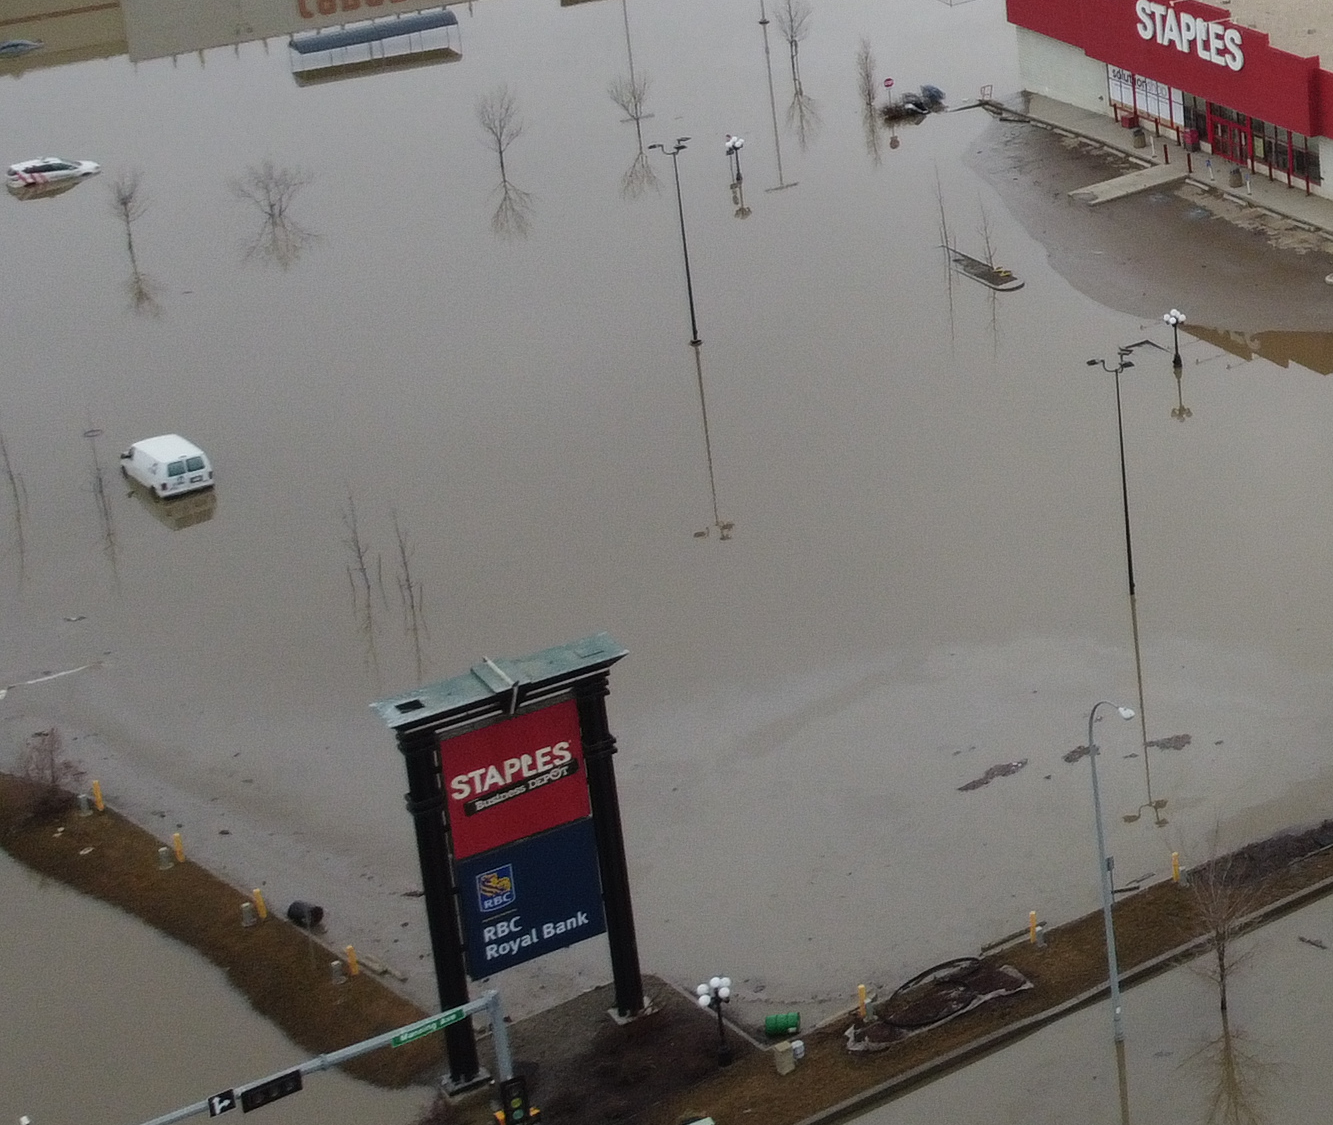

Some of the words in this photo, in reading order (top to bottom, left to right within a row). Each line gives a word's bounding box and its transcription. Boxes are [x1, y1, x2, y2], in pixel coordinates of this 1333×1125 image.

[451, 741, 572, 801] STAPLES
[474, 784, 526, 811] Business
[528, 765, 569, 790] DEPOT
[483, 891, 512, 910] RBC
[483, 915, 523, 943] RBC
[485, 927, 540, 961] Royal
[542, 910, 590, 940] Bank
